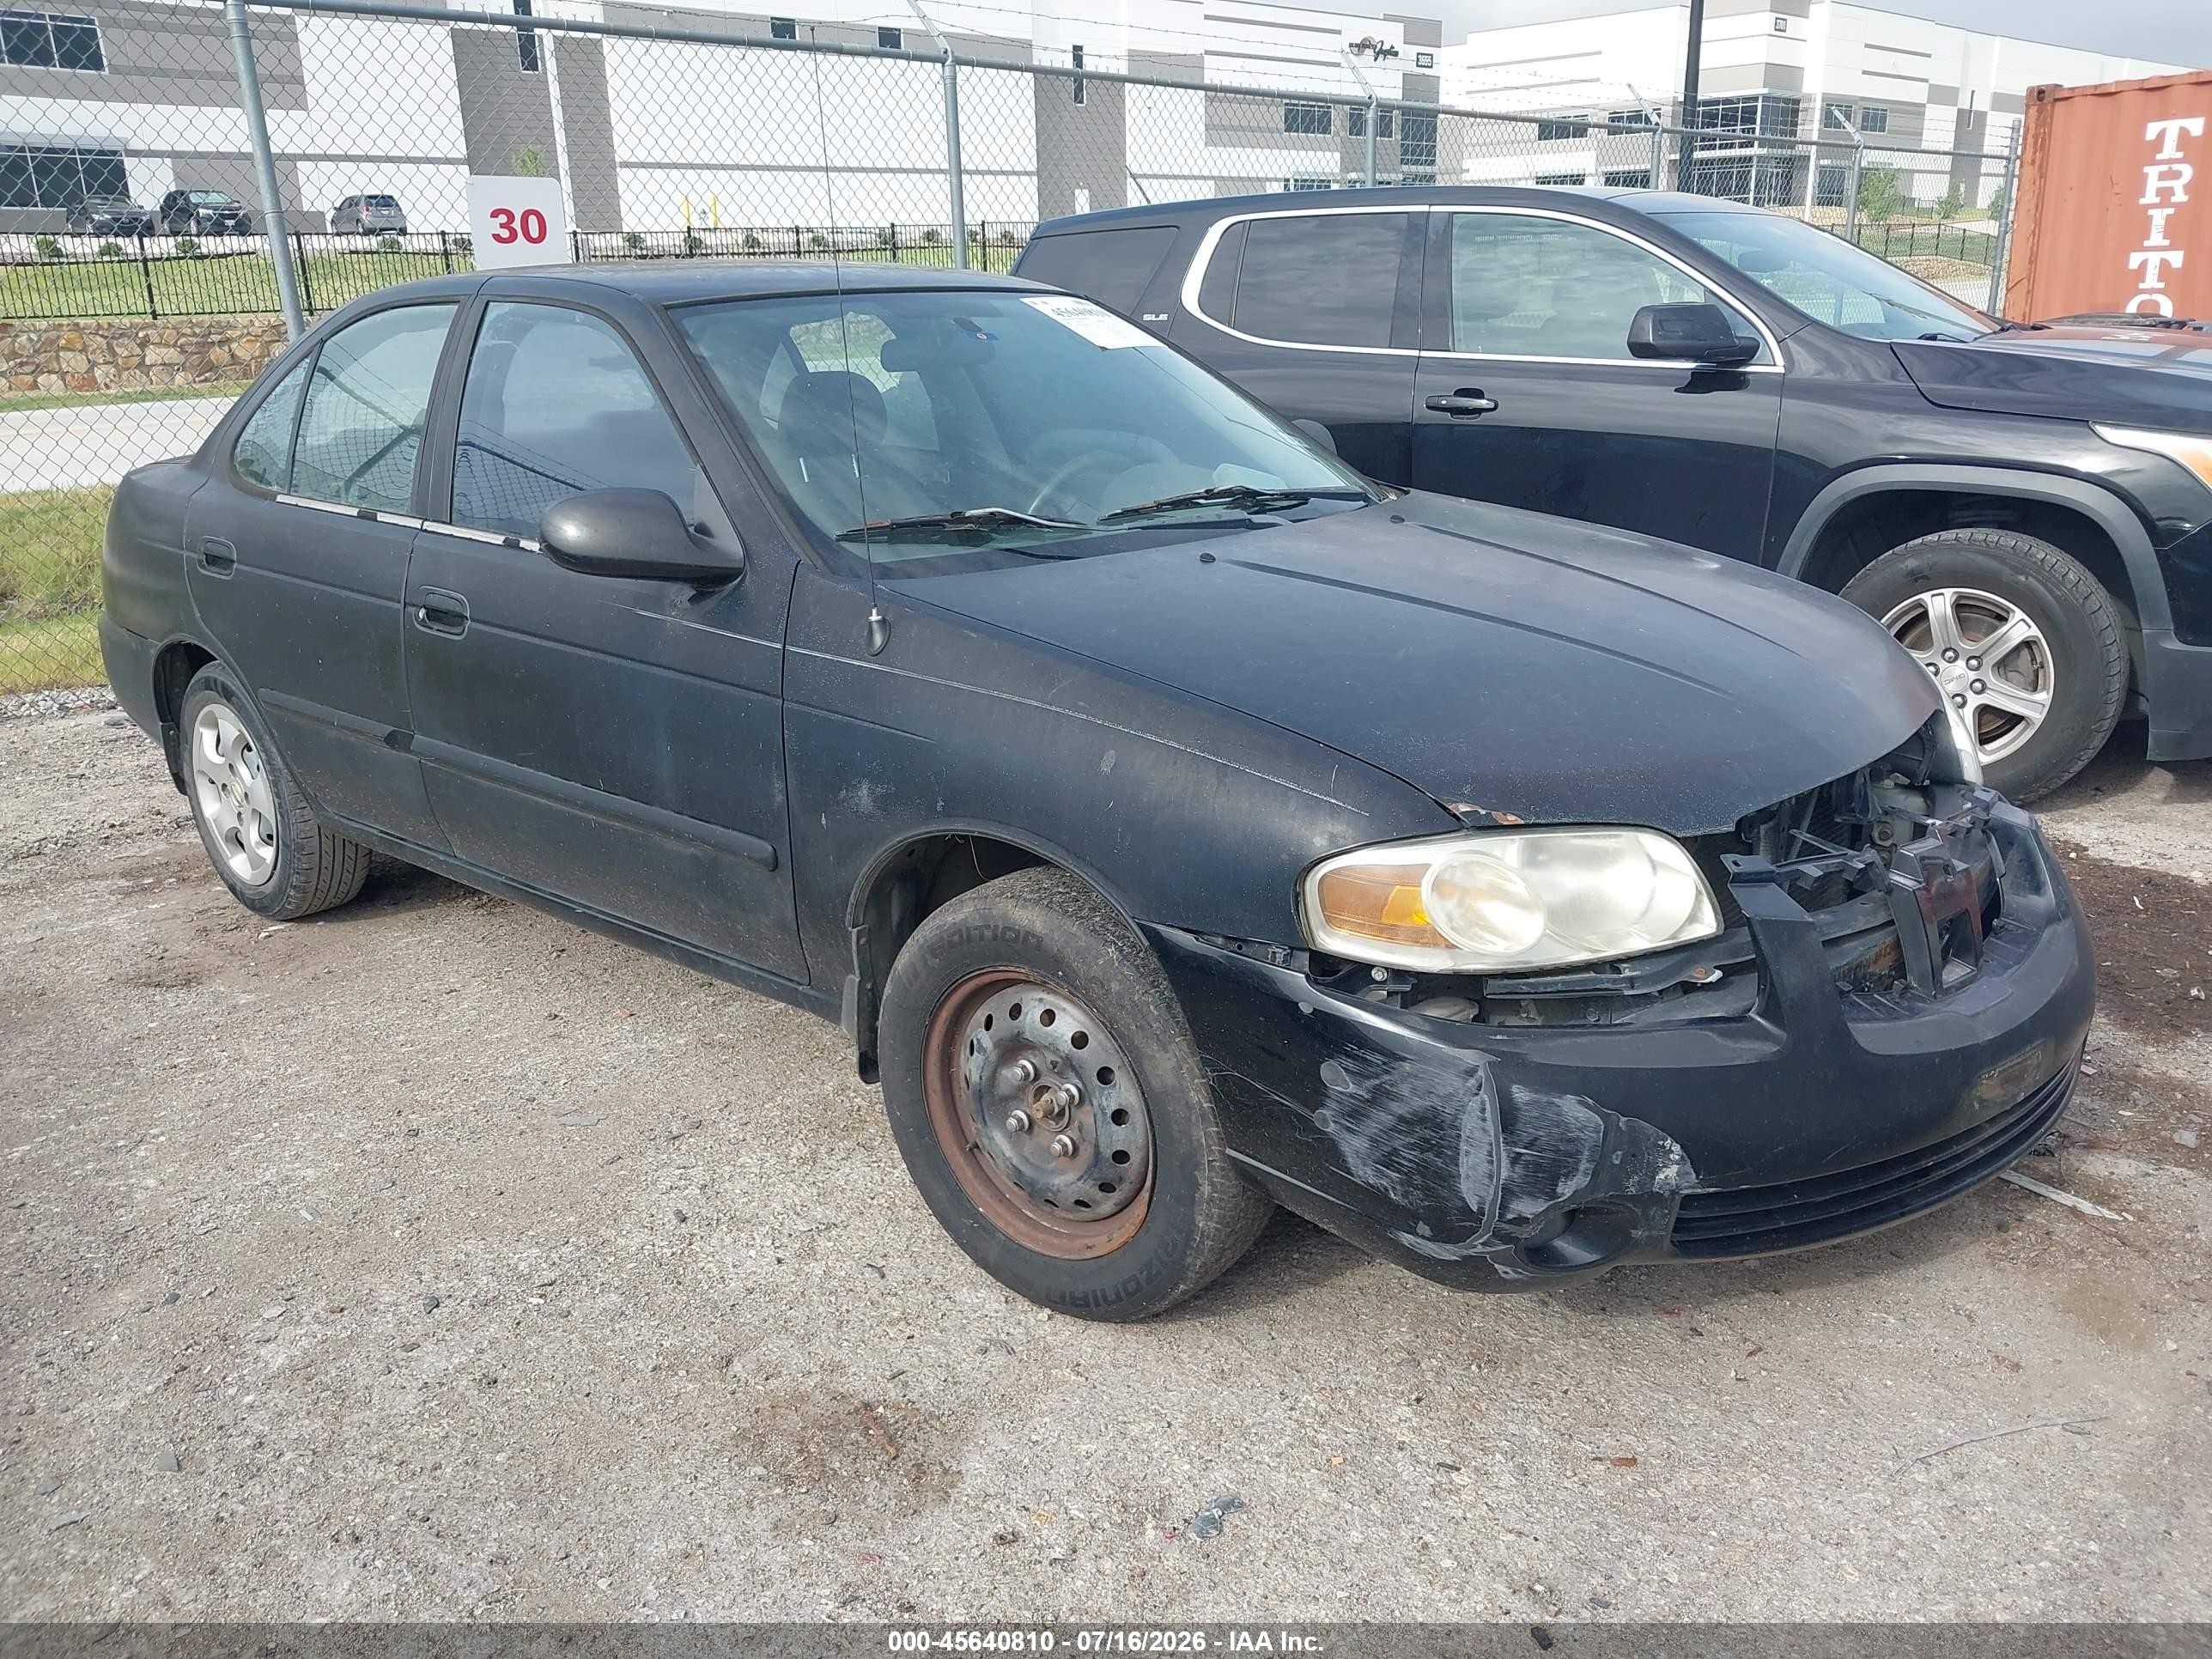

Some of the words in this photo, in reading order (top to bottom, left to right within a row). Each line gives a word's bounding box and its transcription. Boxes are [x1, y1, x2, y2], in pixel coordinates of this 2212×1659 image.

[1418, 55, 1432, 66] 3555
[489, 208, 547, 244] 30
[1943, 673, 1966, 684] GMC
[1041, 1228, 1180, 1309] RIZONIAN
